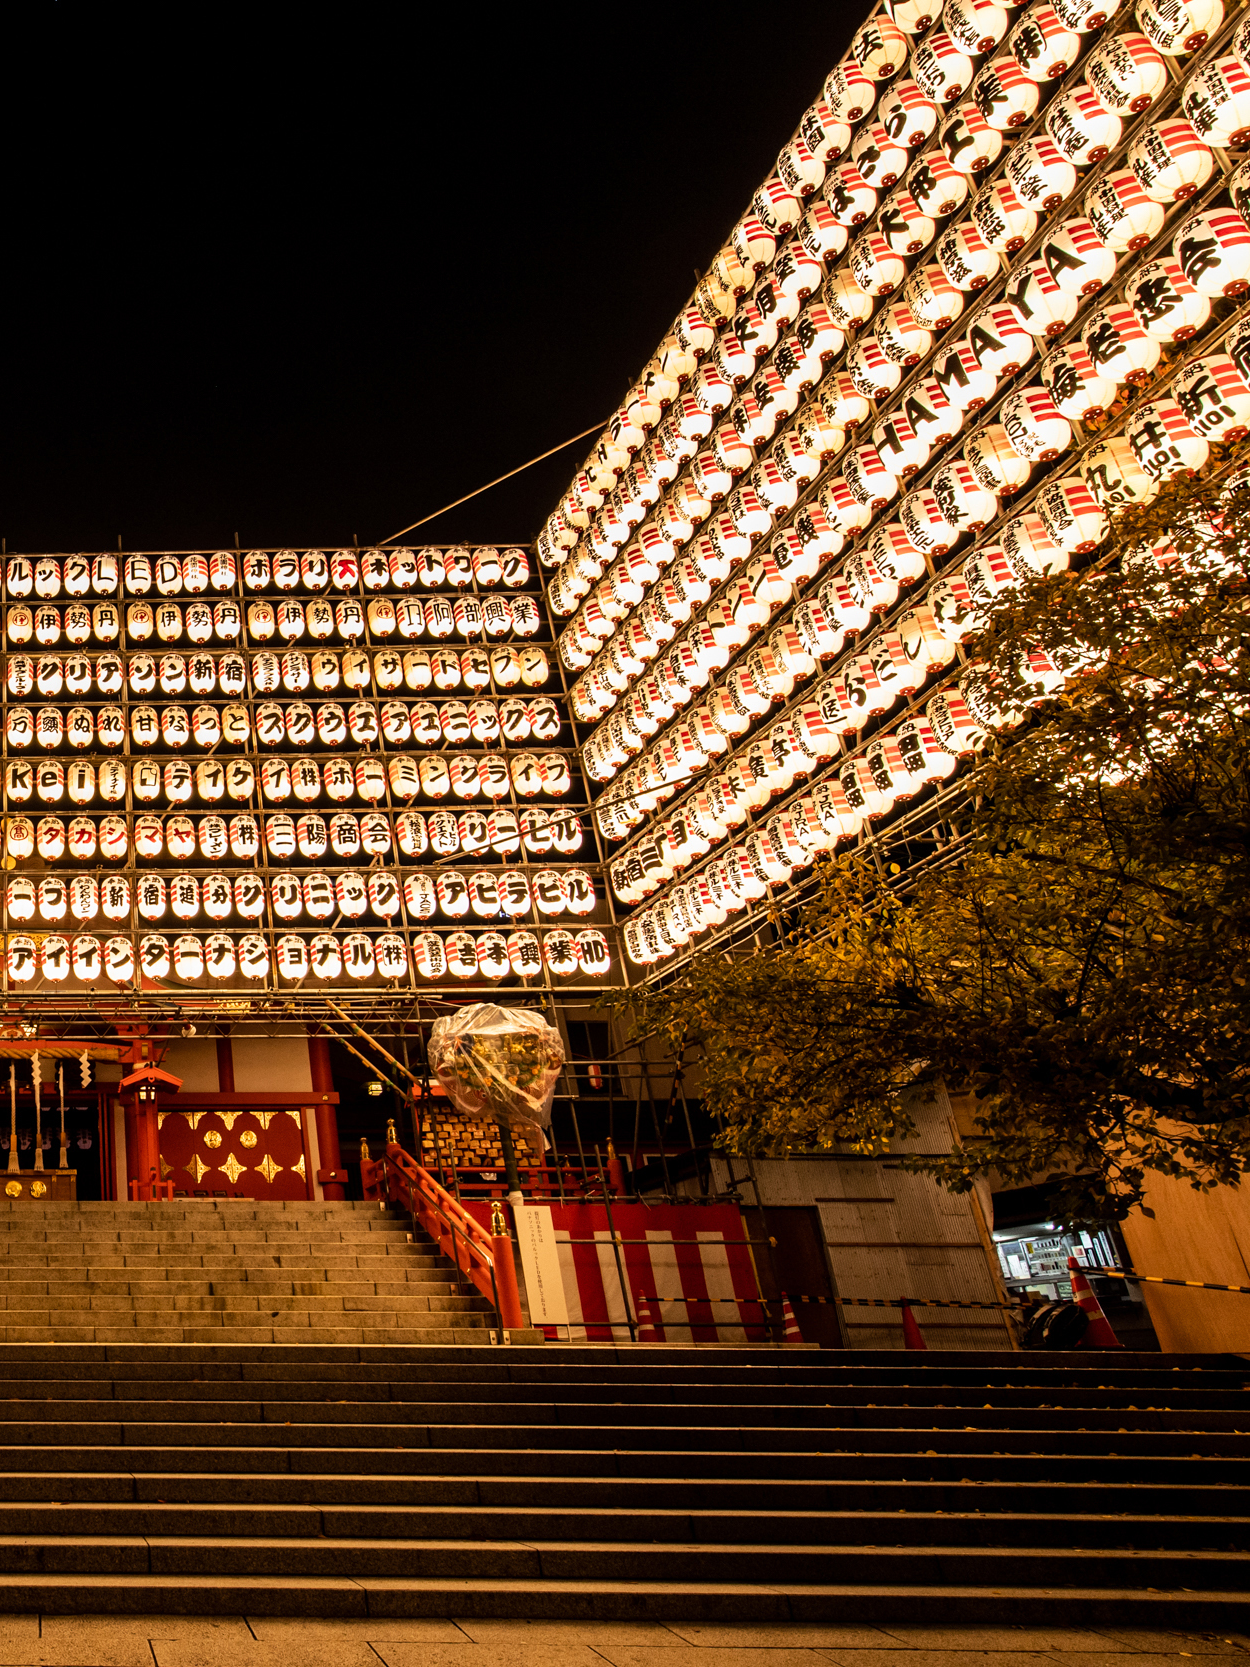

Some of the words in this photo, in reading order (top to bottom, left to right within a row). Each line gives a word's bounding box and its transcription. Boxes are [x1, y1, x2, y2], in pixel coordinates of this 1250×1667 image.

[876, 243, 1087, 456] HAMAYA
[250, 554, 522, 580] ポラリスネットワーク
[38, 609, 115, 630] 伊勢丹
[160, 607, 239, 629] 伊勢丹
[284, 606, 363, 625] 伊勢丹
[433, 601, 534, 626] 阿部興業
[39, 658, 246, 684] クリアソン新宿
[263, 706, 560, 736] スクウエアエニックス
[331, 762, 567, 786] ホーミングライフ
[42, 825, 195, 847] タカシマヤ
[108, 882, 398, 907] 新宿追分クリニック
[458, 939, 604, 968] 吉本興業HD
